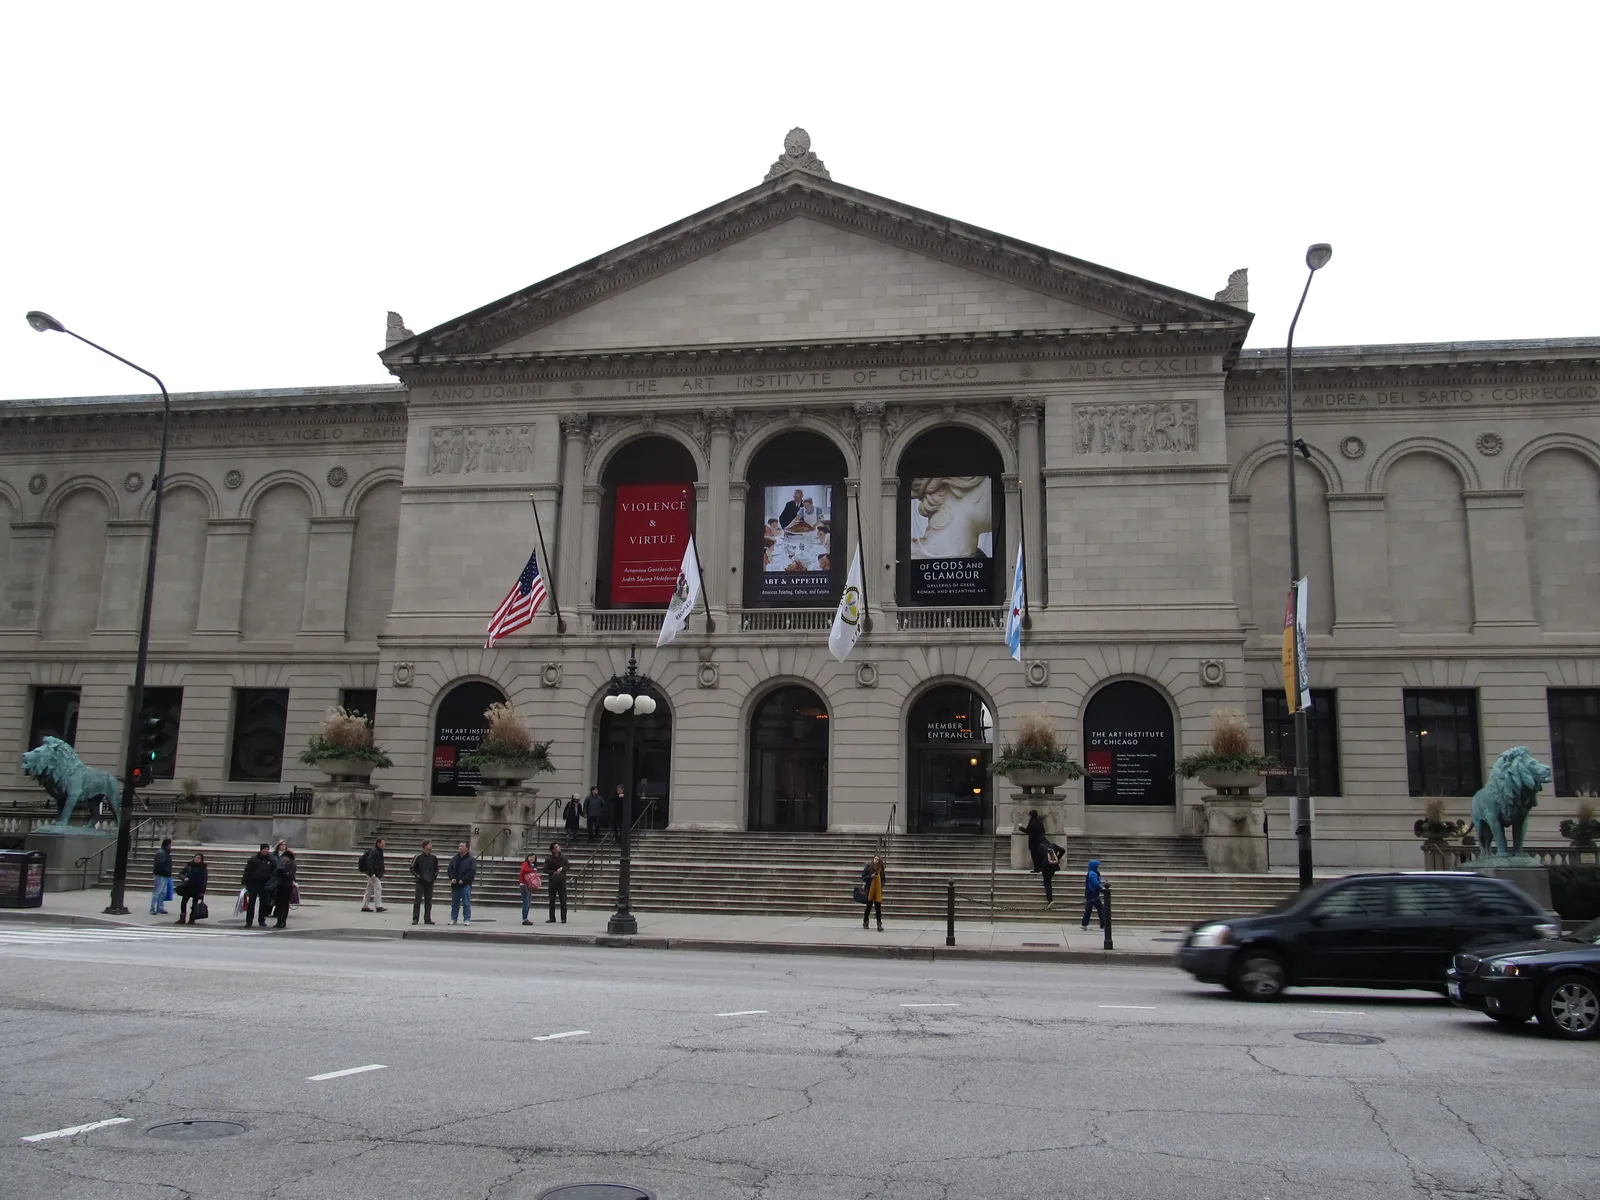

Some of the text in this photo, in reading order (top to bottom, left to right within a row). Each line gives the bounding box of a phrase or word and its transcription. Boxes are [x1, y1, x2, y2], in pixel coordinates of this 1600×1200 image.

[1069, 359, 1198, 375] MDCCCXCII
[623, 366, 979, 393] THE ART INSTITVTE OF CHICAGO
[430, 384, 542, 401] ANNO DOMINI
[1232, 385, 1598, 408] TITIAN ANDREA DEL SARTO CORREGGIO
[212, 430, 275, 444] MICHAEL
[281, 428, 344, 442] ANGELO
[621, 500, 687, 512] VIOLENCE
[648, 519, 657, 528] &
[629, 534, 676, 545] VIRTUE
[919, 562, 930, 570] OF
[932, 560, 963, 570] GODS
[790, 577, 829, 585] APPETITE
[923, 569, 980, 581] GLAMOUR
[927, 722, 963, 730] MEMBER
[927, 731, 974, 739] ENTRANCE
